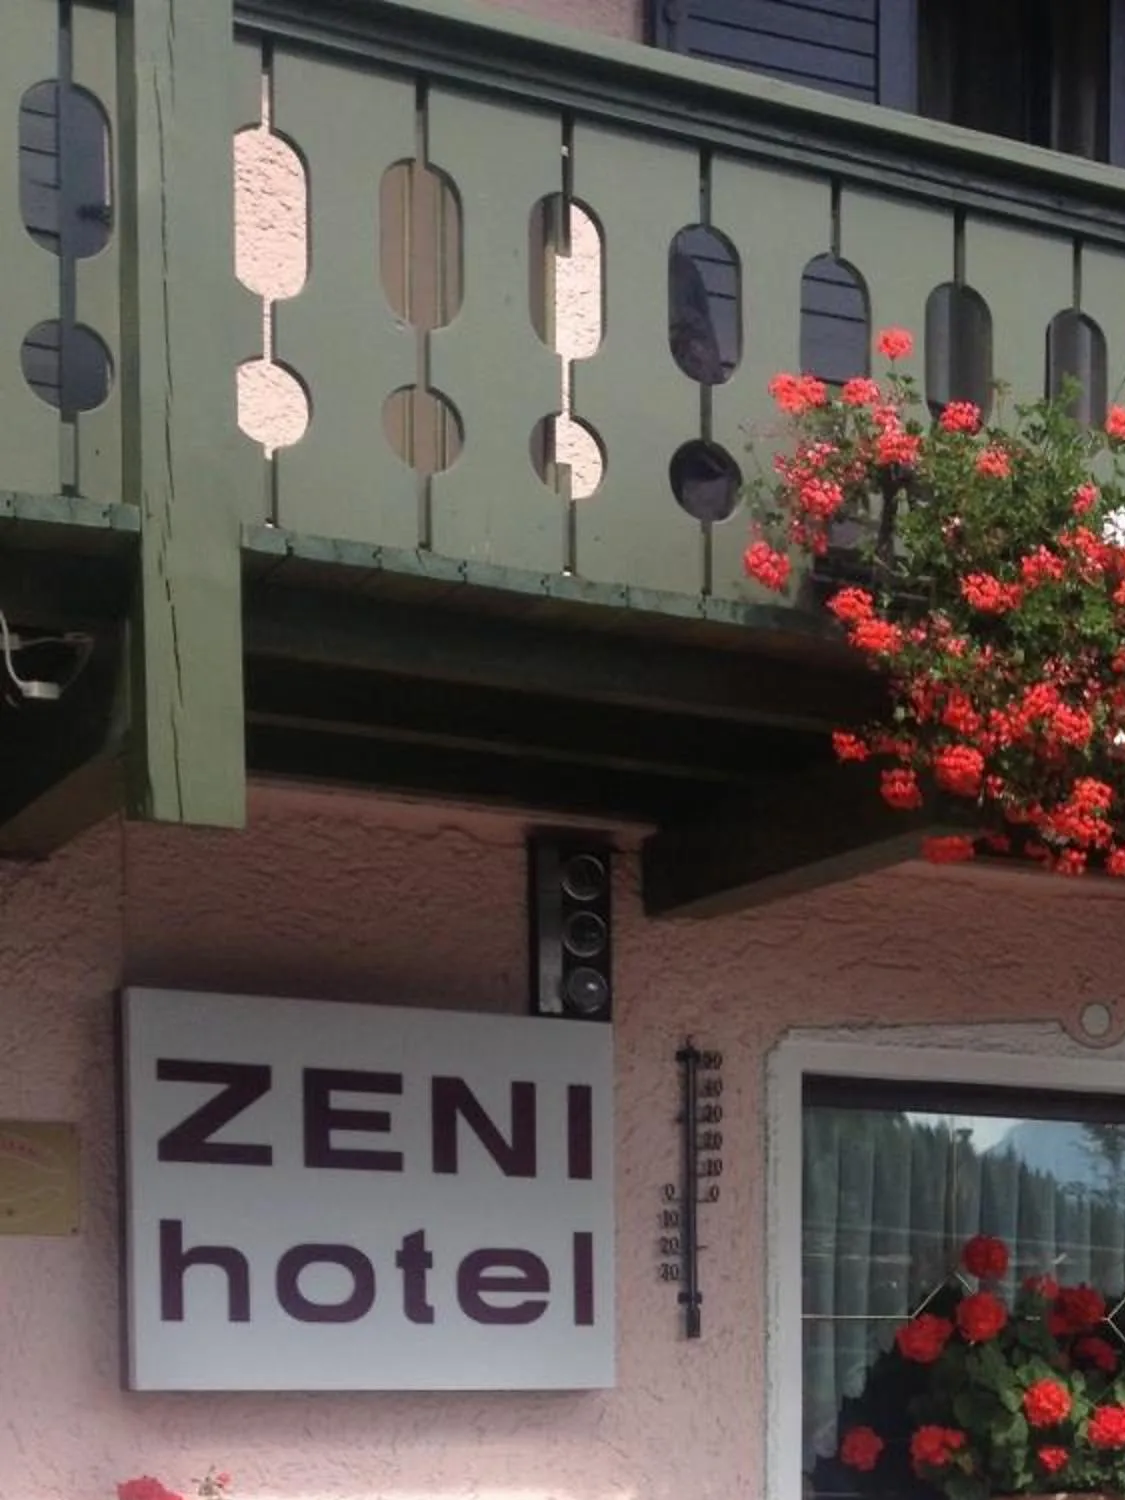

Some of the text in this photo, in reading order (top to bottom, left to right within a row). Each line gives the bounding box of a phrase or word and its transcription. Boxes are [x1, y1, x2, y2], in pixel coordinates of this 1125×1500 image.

[156, 1058, 593, 1180] ZENI
[665, 1184, 675, 1200] 0
[709, 1185, 719, 1202] 0
[159, 1219, 594, 1326] hotel
